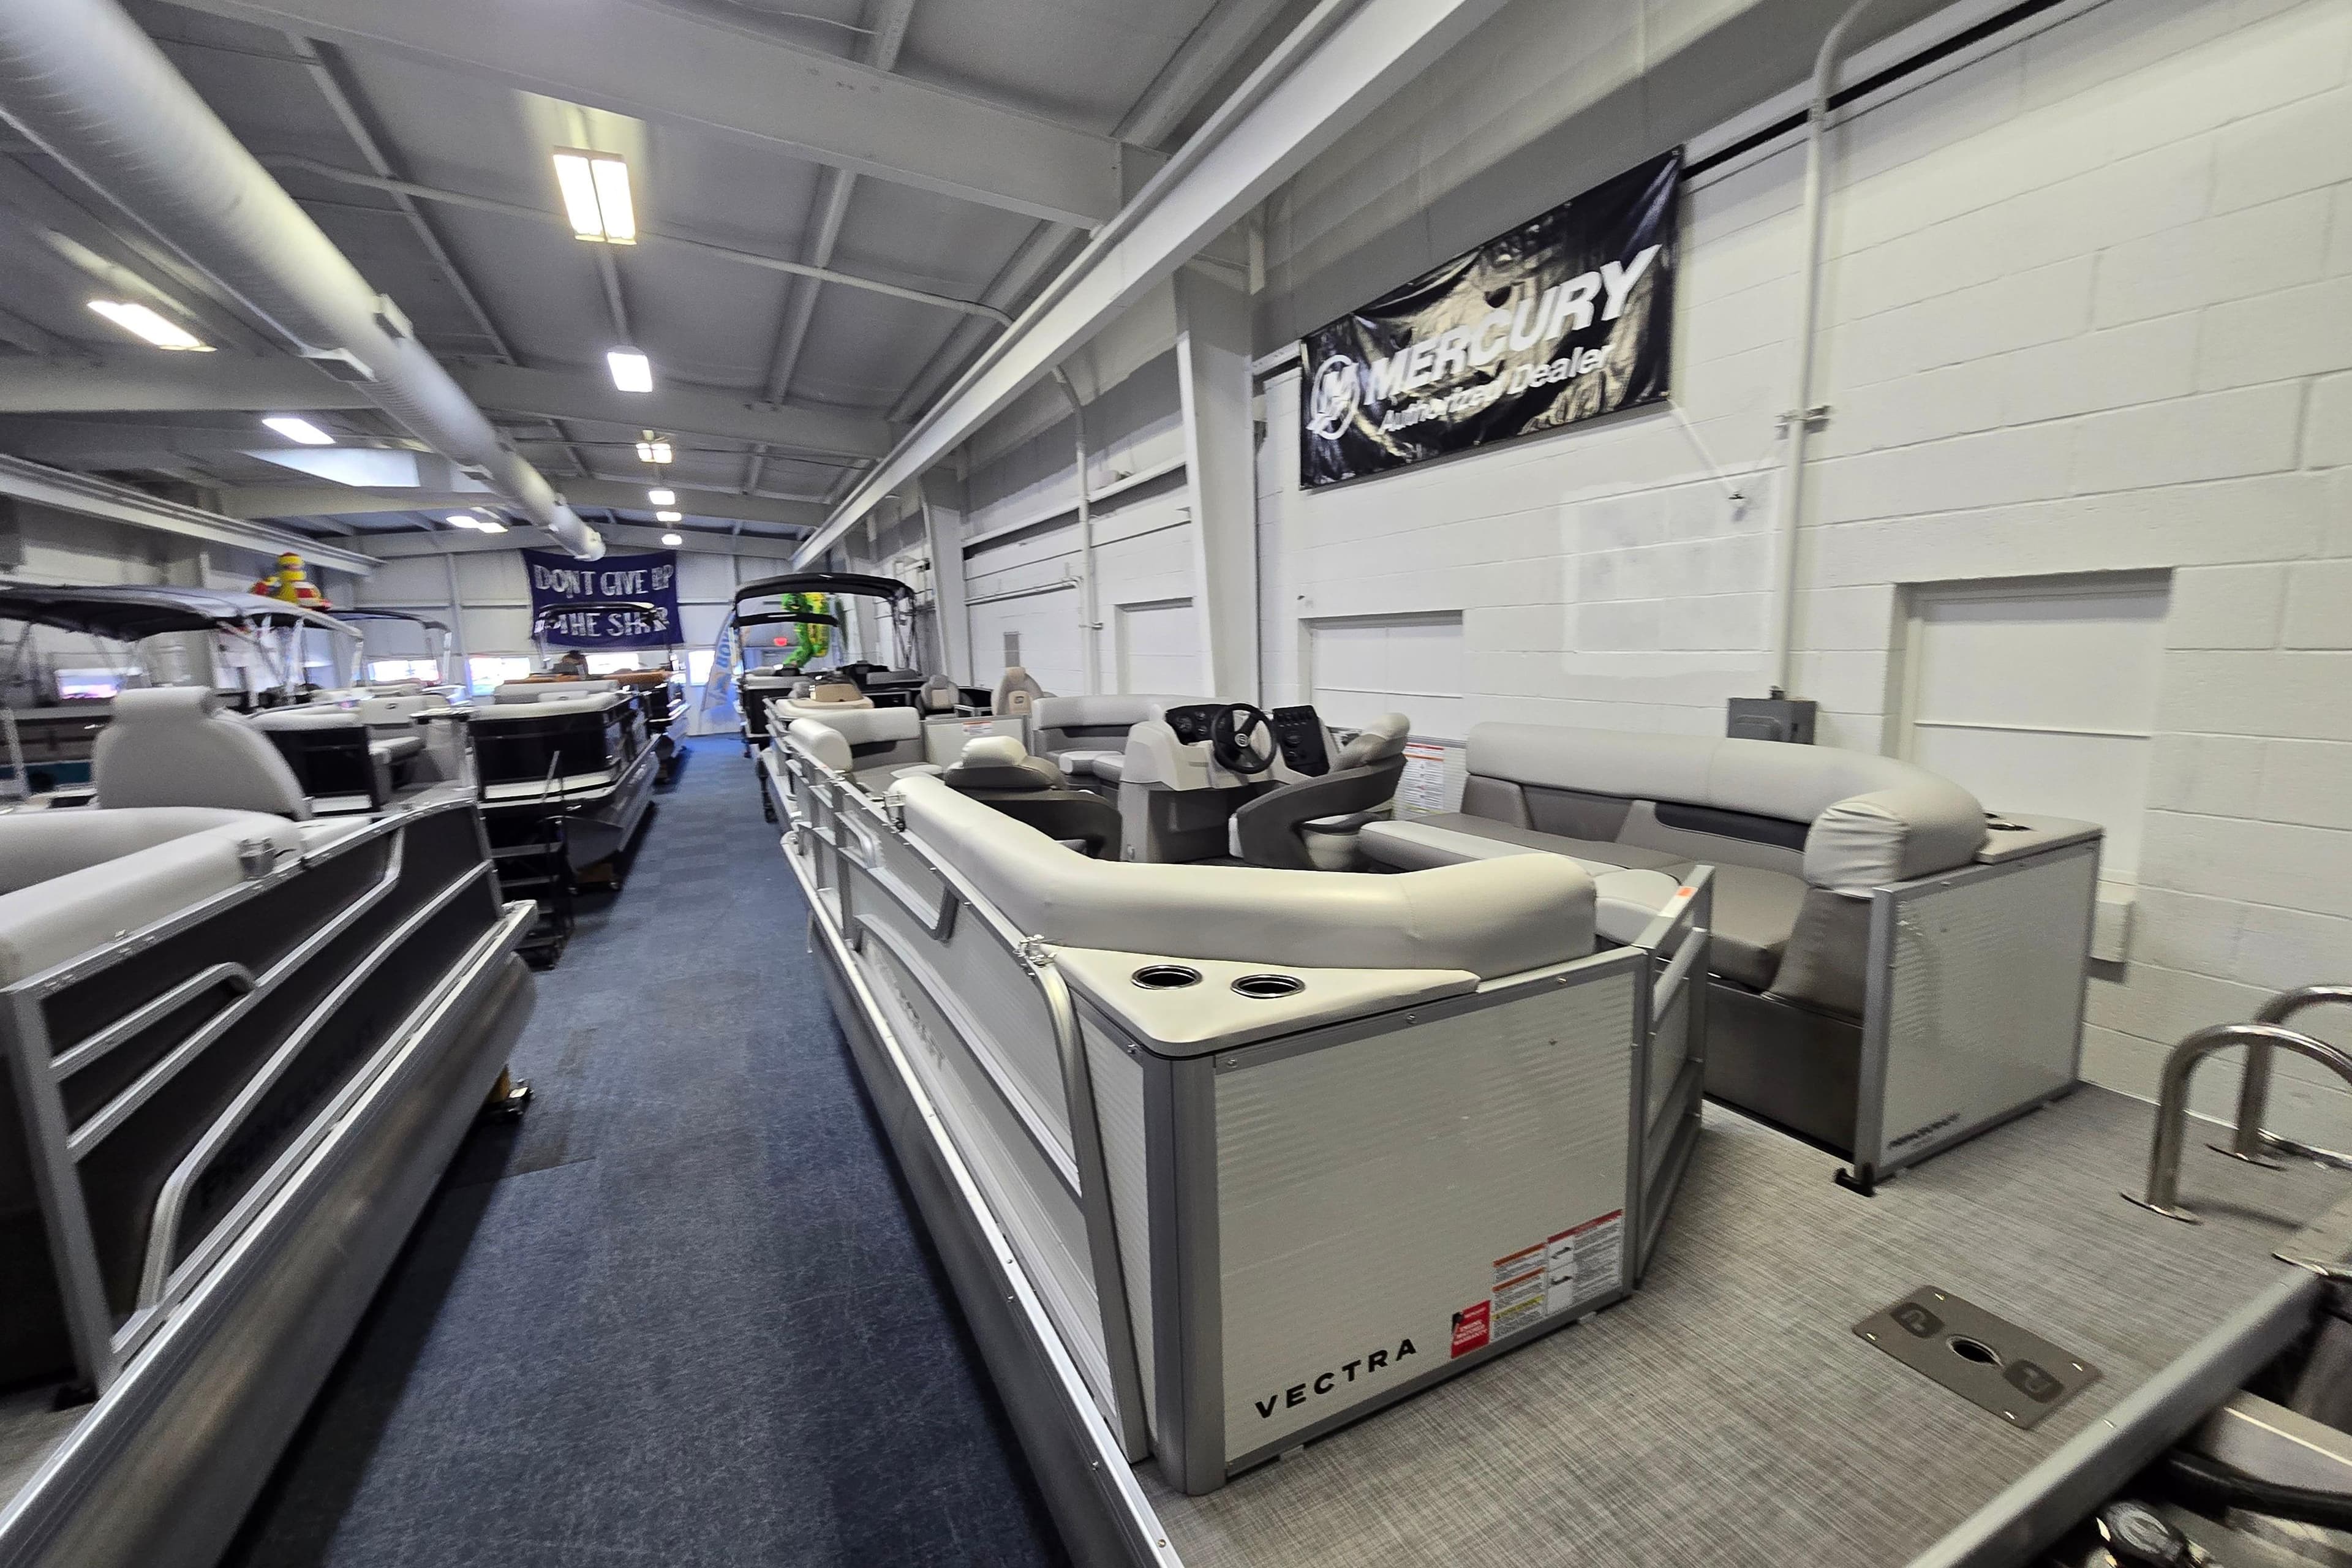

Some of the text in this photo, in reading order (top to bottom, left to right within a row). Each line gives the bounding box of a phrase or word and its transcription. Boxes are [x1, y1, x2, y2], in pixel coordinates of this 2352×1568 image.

[1363, 244, 1662, 405] MERCURY
[1377, 343, 1616, 435] Authorized Dealer
[600, 569, 649, 596] GIVE
[557, 612, 602, 636] THE
[1255, 1338, 1416, 1419] VECTRA
